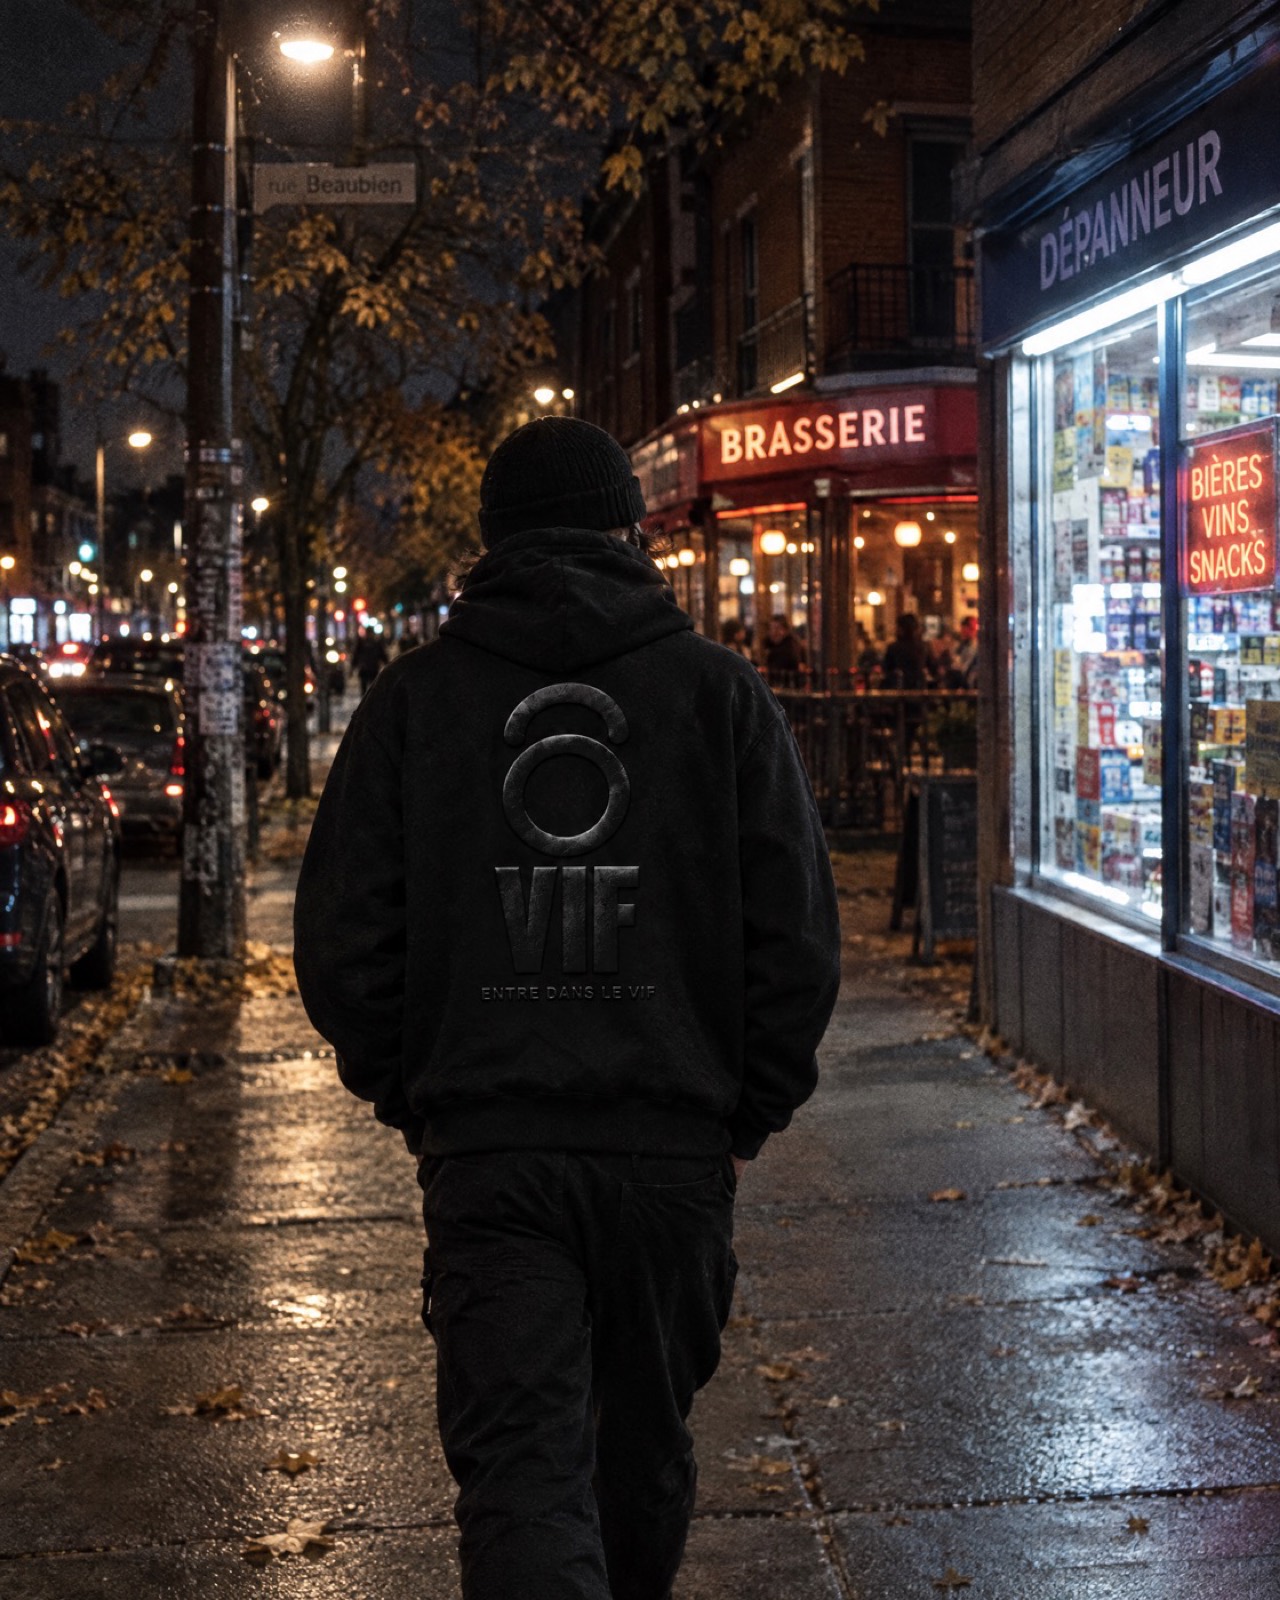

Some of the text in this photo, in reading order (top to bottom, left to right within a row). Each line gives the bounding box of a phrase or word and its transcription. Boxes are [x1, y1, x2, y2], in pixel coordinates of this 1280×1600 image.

[269, 174, 402, 194] rue Beaubien
[1040, 129, 1223, 291] DÉPANNEUR
[720, 404, 926, 464] BRASSERIE
[1191, 453, 1263, 502] BIÈRES
[1201, 498, 1250, 539] VINS
[1189, 538, 1266, 584] SNACKS
[494, 864, 640, 975] VIF
[480, 985, 657, 1001] ENTRE DANS LE VIF
